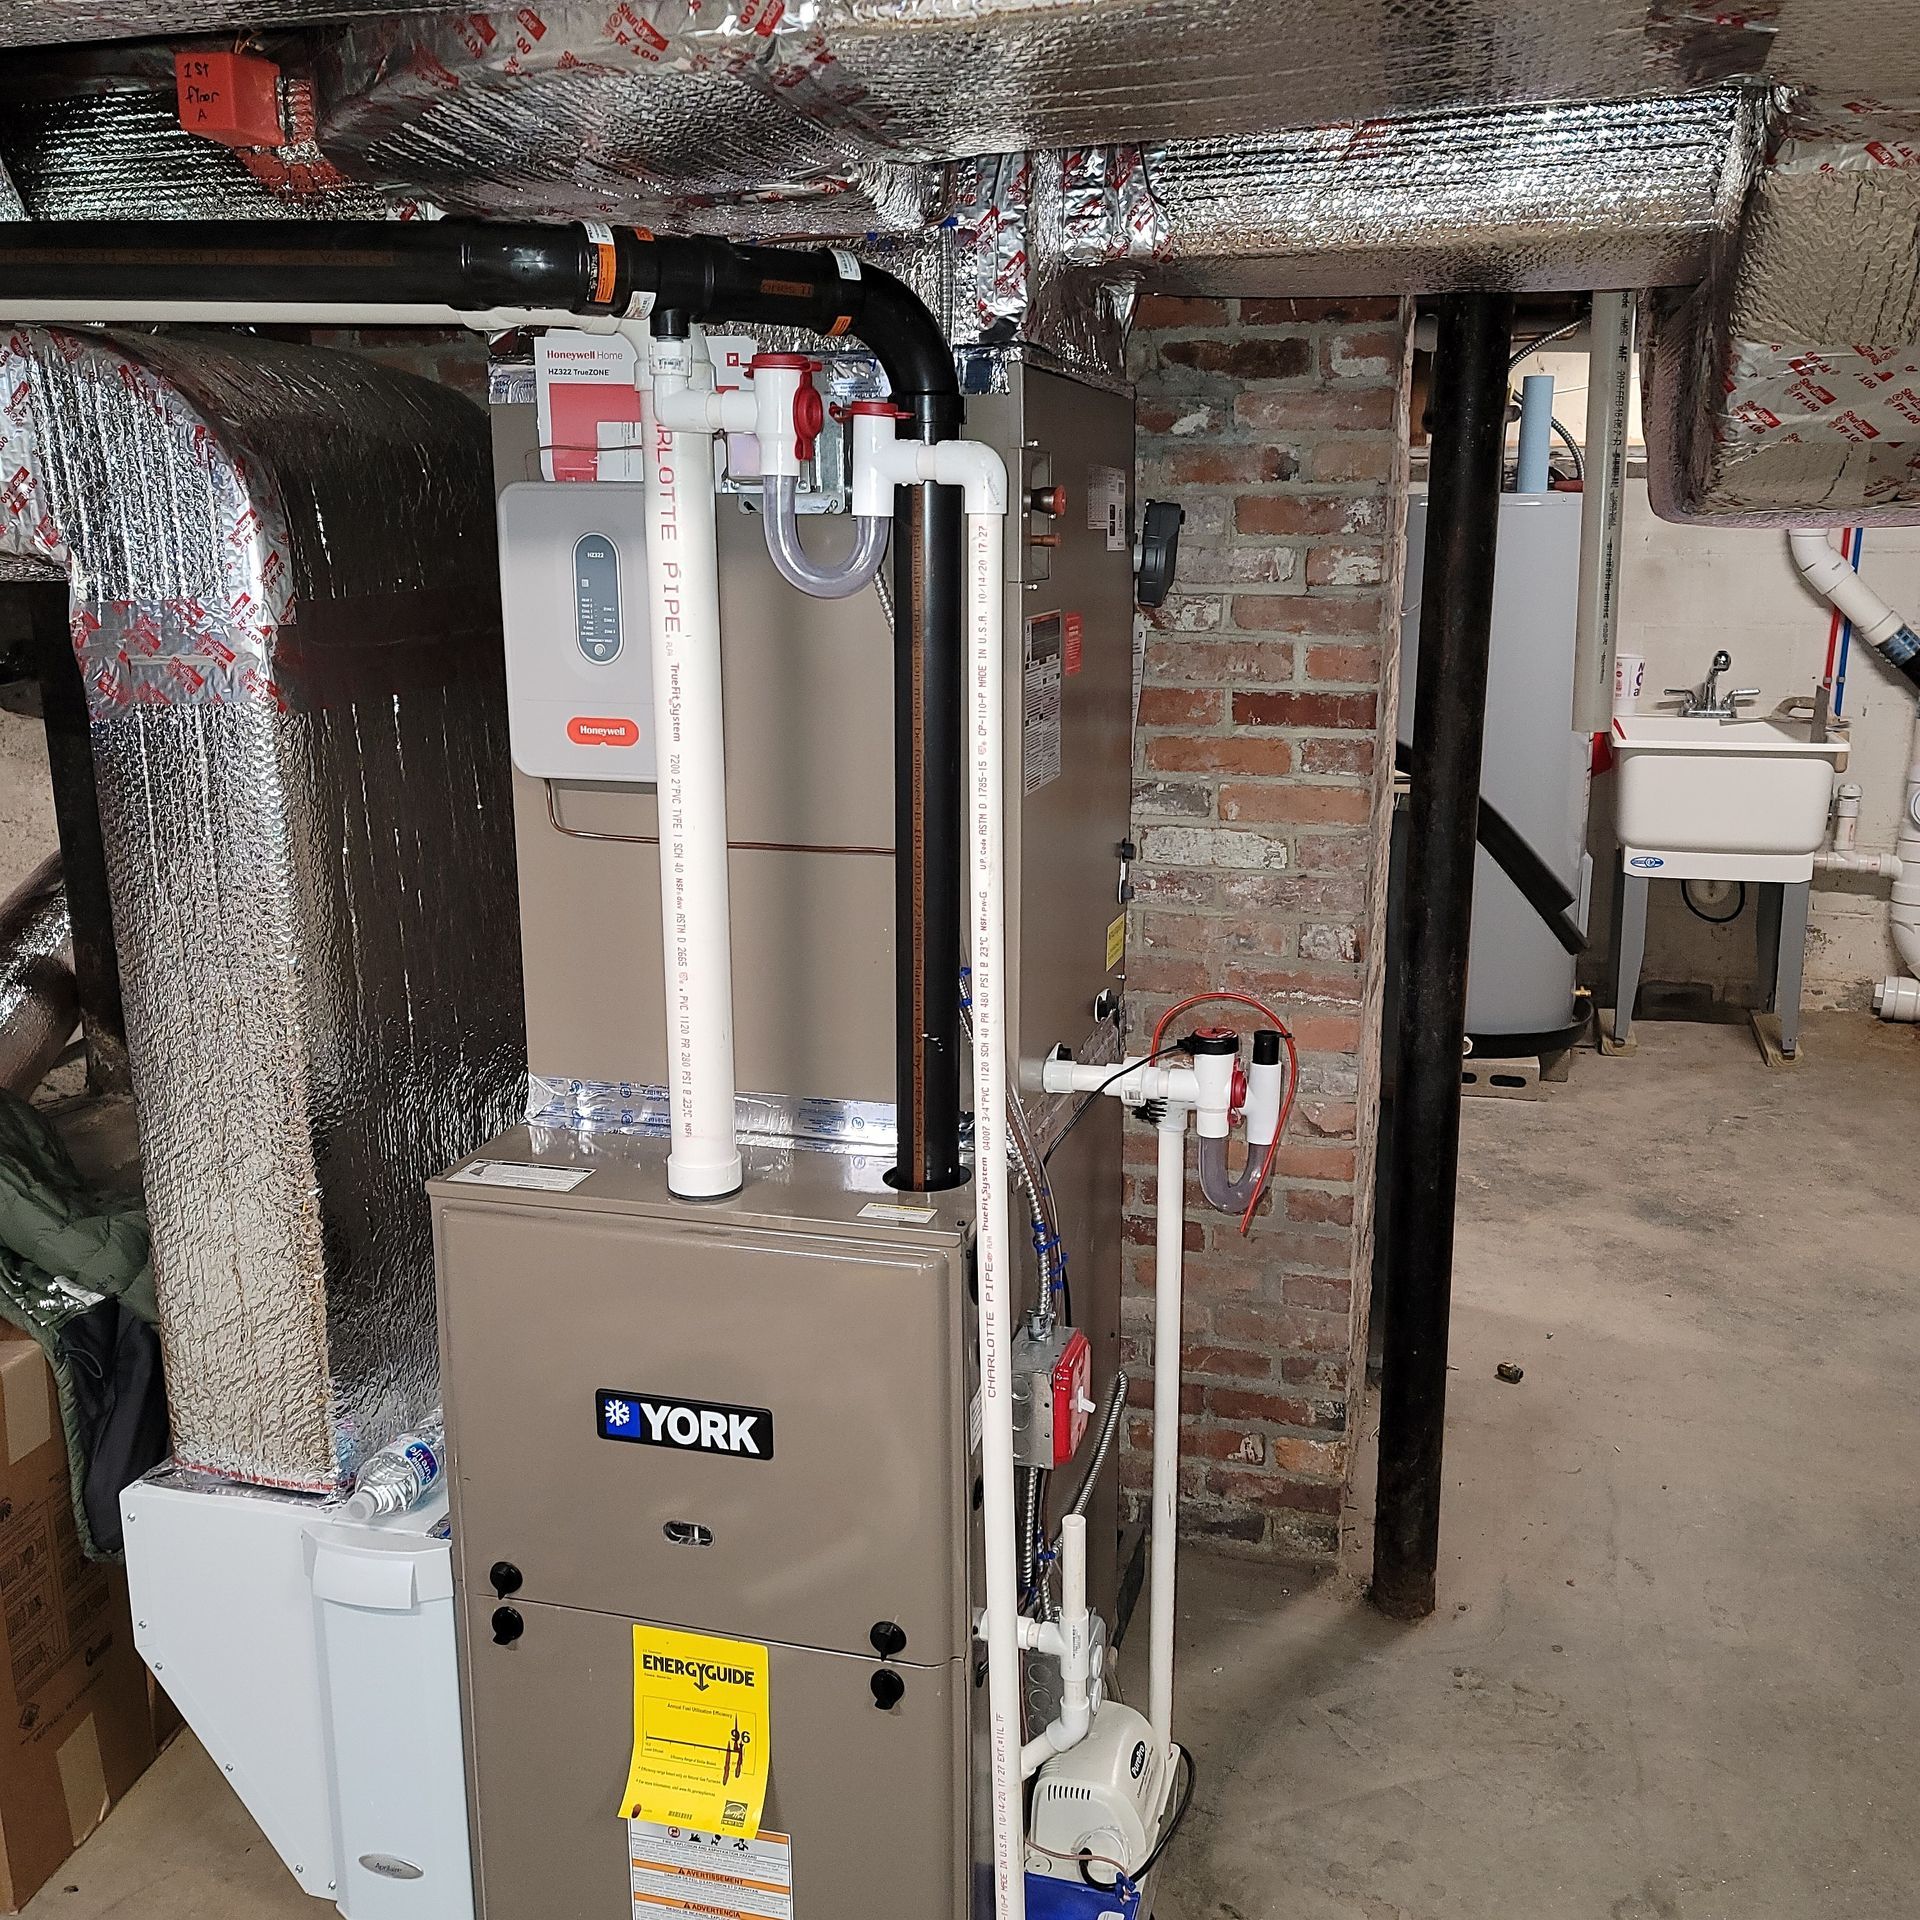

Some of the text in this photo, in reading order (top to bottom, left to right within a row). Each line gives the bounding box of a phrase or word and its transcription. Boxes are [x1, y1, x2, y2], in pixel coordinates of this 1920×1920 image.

[197, 108, 208, 121] A
[546, 349, 623, 361] Honeywell Home
[547, 367, 573, 377] HZ322
[1802, 399, 1821, 413] 100
[655, 424, 677, 541] RLOTTE
[587, 551, 605, 559] HZ322
[662, 562, 681, 633] PIPE
[978, 648, 988, 660] IN
[978, 665, 988, 688] MADE
[579, 725, 627, 737] Honeywell
[669, 702, 683, 742] System
[669, 753, 681, 775] 7200
[671, 808, 683, 830] TYPE
[978, 812, 989, 836] ASTM
[672, 842, 684, 859] SCH
[673, 862, 685, 873] 40
[676, 912, 688, 934] ASTM
[978, 936, 989, 957] 23°C
[914, 958, 924, 996] Made
[978, 973, 989, 988] PSI
[679, 995, 690, 1011] PVC
[679, 1015, 691, 1035] 1120
[979, 1012, 990, 1024] PR
[979, 1028, 990, 1038] 40
[680, 1037, 691, 1049] PR
[979, 1042, 990, 1058] SCH
[681, 1052, 692, 1068] 280
[681, 1070, 692, 1086] PSI
[980, 1062, 990, 1082] 1120
[980, 1156, 992, 1195] System
[984, 1261, 995, 1302] PIPE
[985, 1310, 997, 1399] CHARLOTTE
[639, 1402, 760, 1454] YORK
[642, 1654, 755, 1691] ENERGYGUIDE
[730, 1728, 751, 1744] 96
[1131, 1743, 1147, 1779] PurePro
[998, 1859, 1008, 1870] IN
[998, 1872, 1008, 1893] MADE
